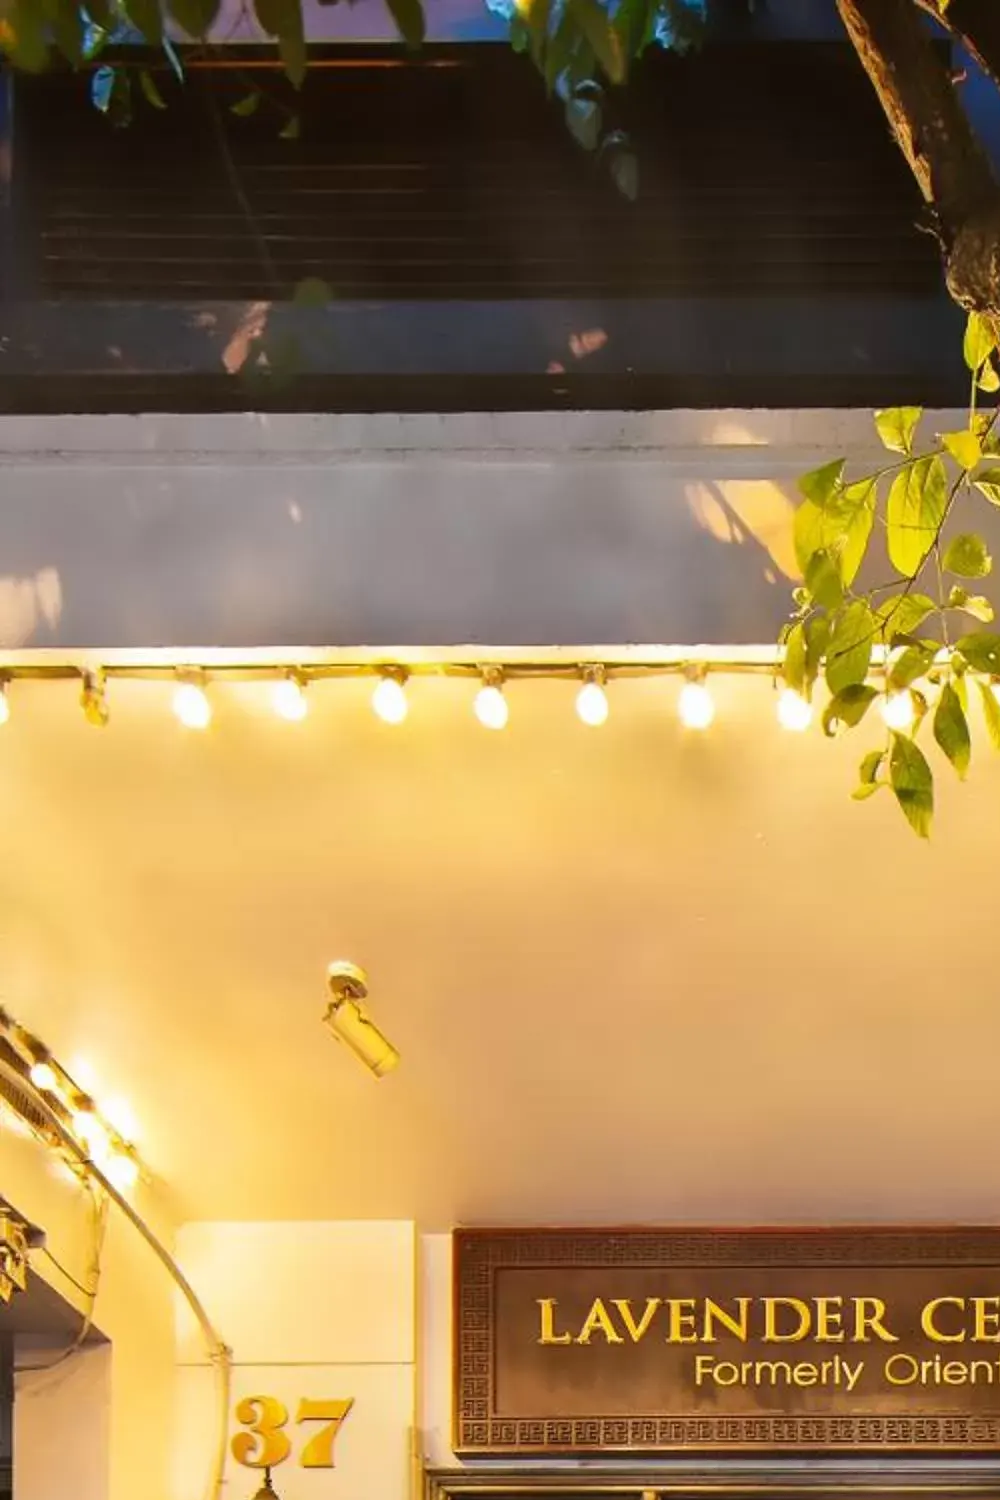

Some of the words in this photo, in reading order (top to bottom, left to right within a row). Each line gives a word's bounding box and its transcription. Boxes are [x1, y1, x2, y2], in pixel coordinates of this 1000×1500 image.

[536, 1296, 899, 1345] LAVENDER
[695, 1354, 864, 1390] Formerly
[230, 1396, 354, 1469] 37
